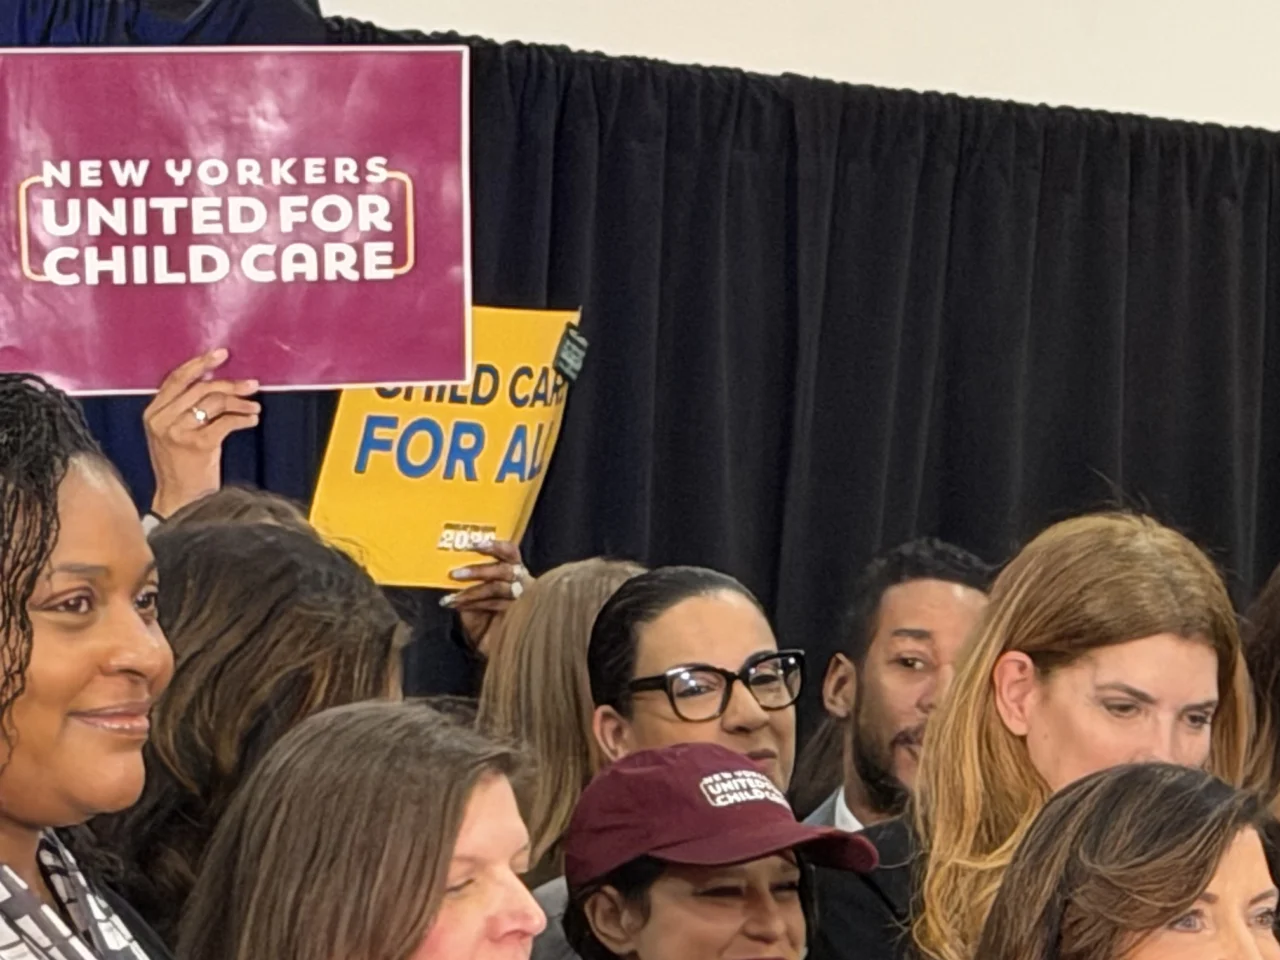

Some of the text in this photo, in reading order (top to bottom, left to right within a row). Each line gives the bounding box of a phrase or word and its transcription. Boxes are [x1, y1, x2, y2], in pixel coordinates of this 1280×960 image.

[42, 156, 389, 188] NEW YORKERS
[42, 194, 393, 236] UNITED FOR
[42, 241, 395, 285] CHILD CARE
[354, 414, 485, 481] FOR
[715, 788, 765, 806] CHILD
